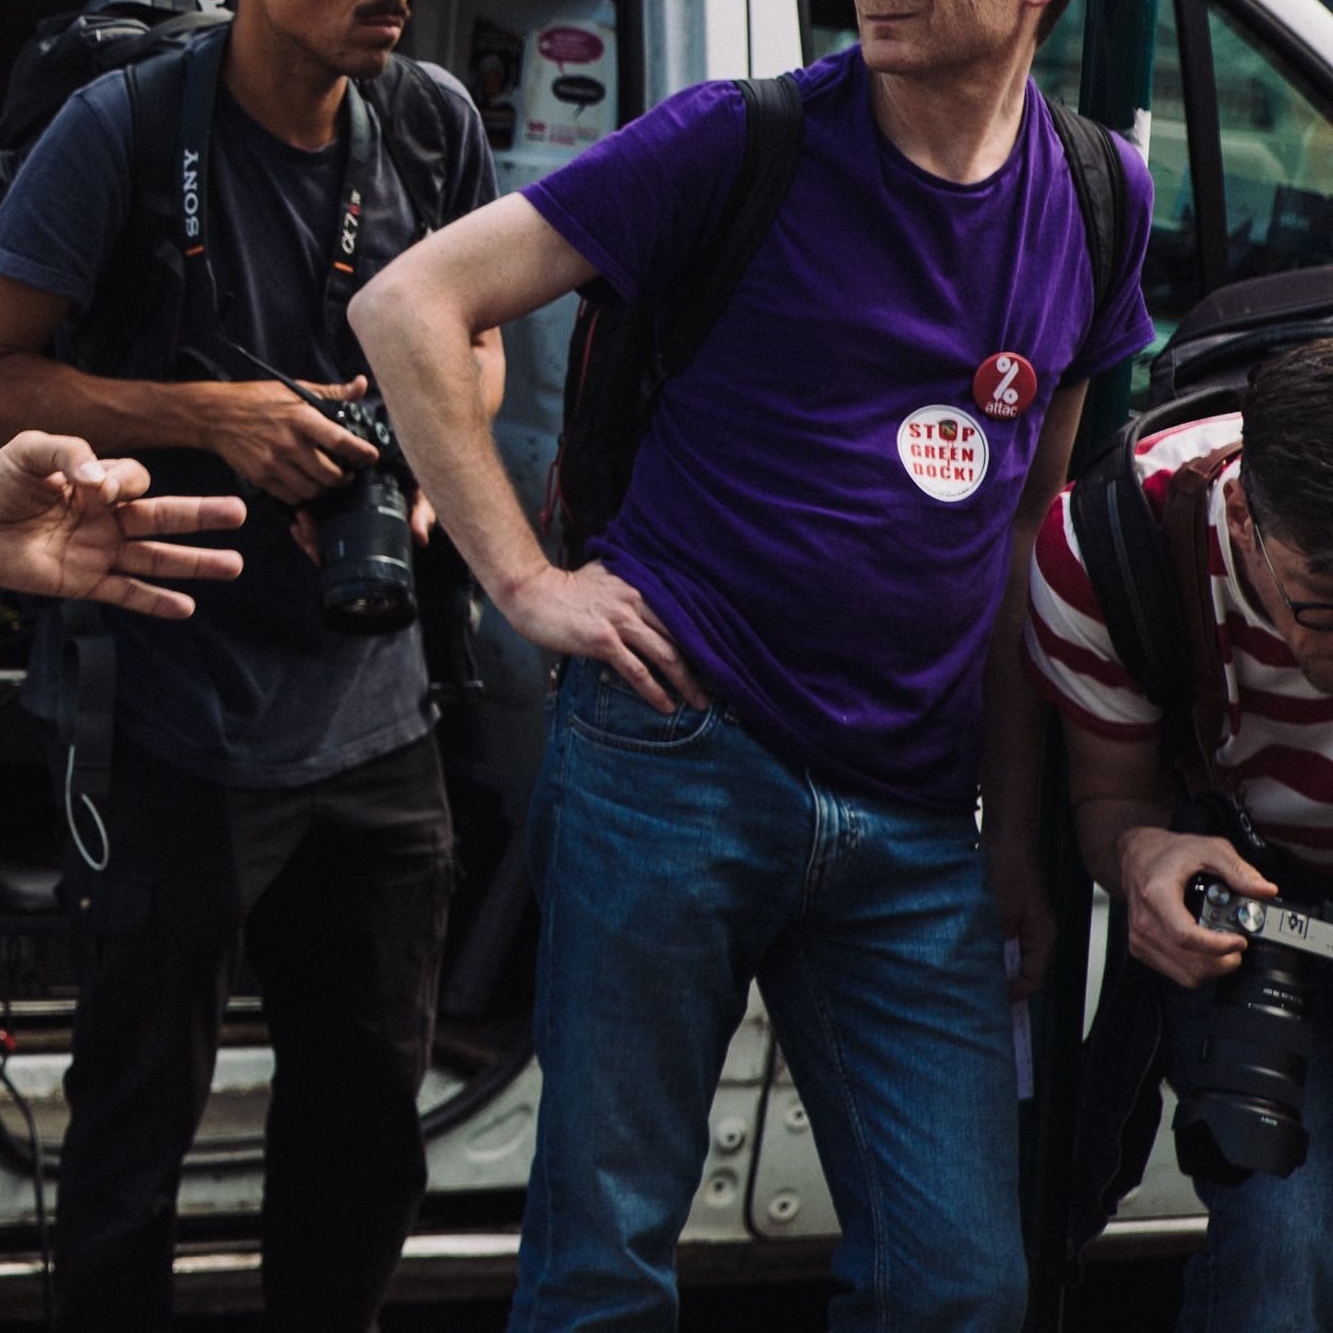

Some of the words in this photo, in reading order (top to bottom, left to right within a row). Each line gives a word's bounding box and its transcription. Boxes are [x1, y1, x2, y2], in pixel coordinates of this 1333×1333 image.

[183, 149, 200, 238] SONY
[984, 400, 1019, 416] attac
[908, 419, 976, 442] STOP
[910, 444, 975, 462] GREEN
[912, 462, 975, 482] DOCK!
